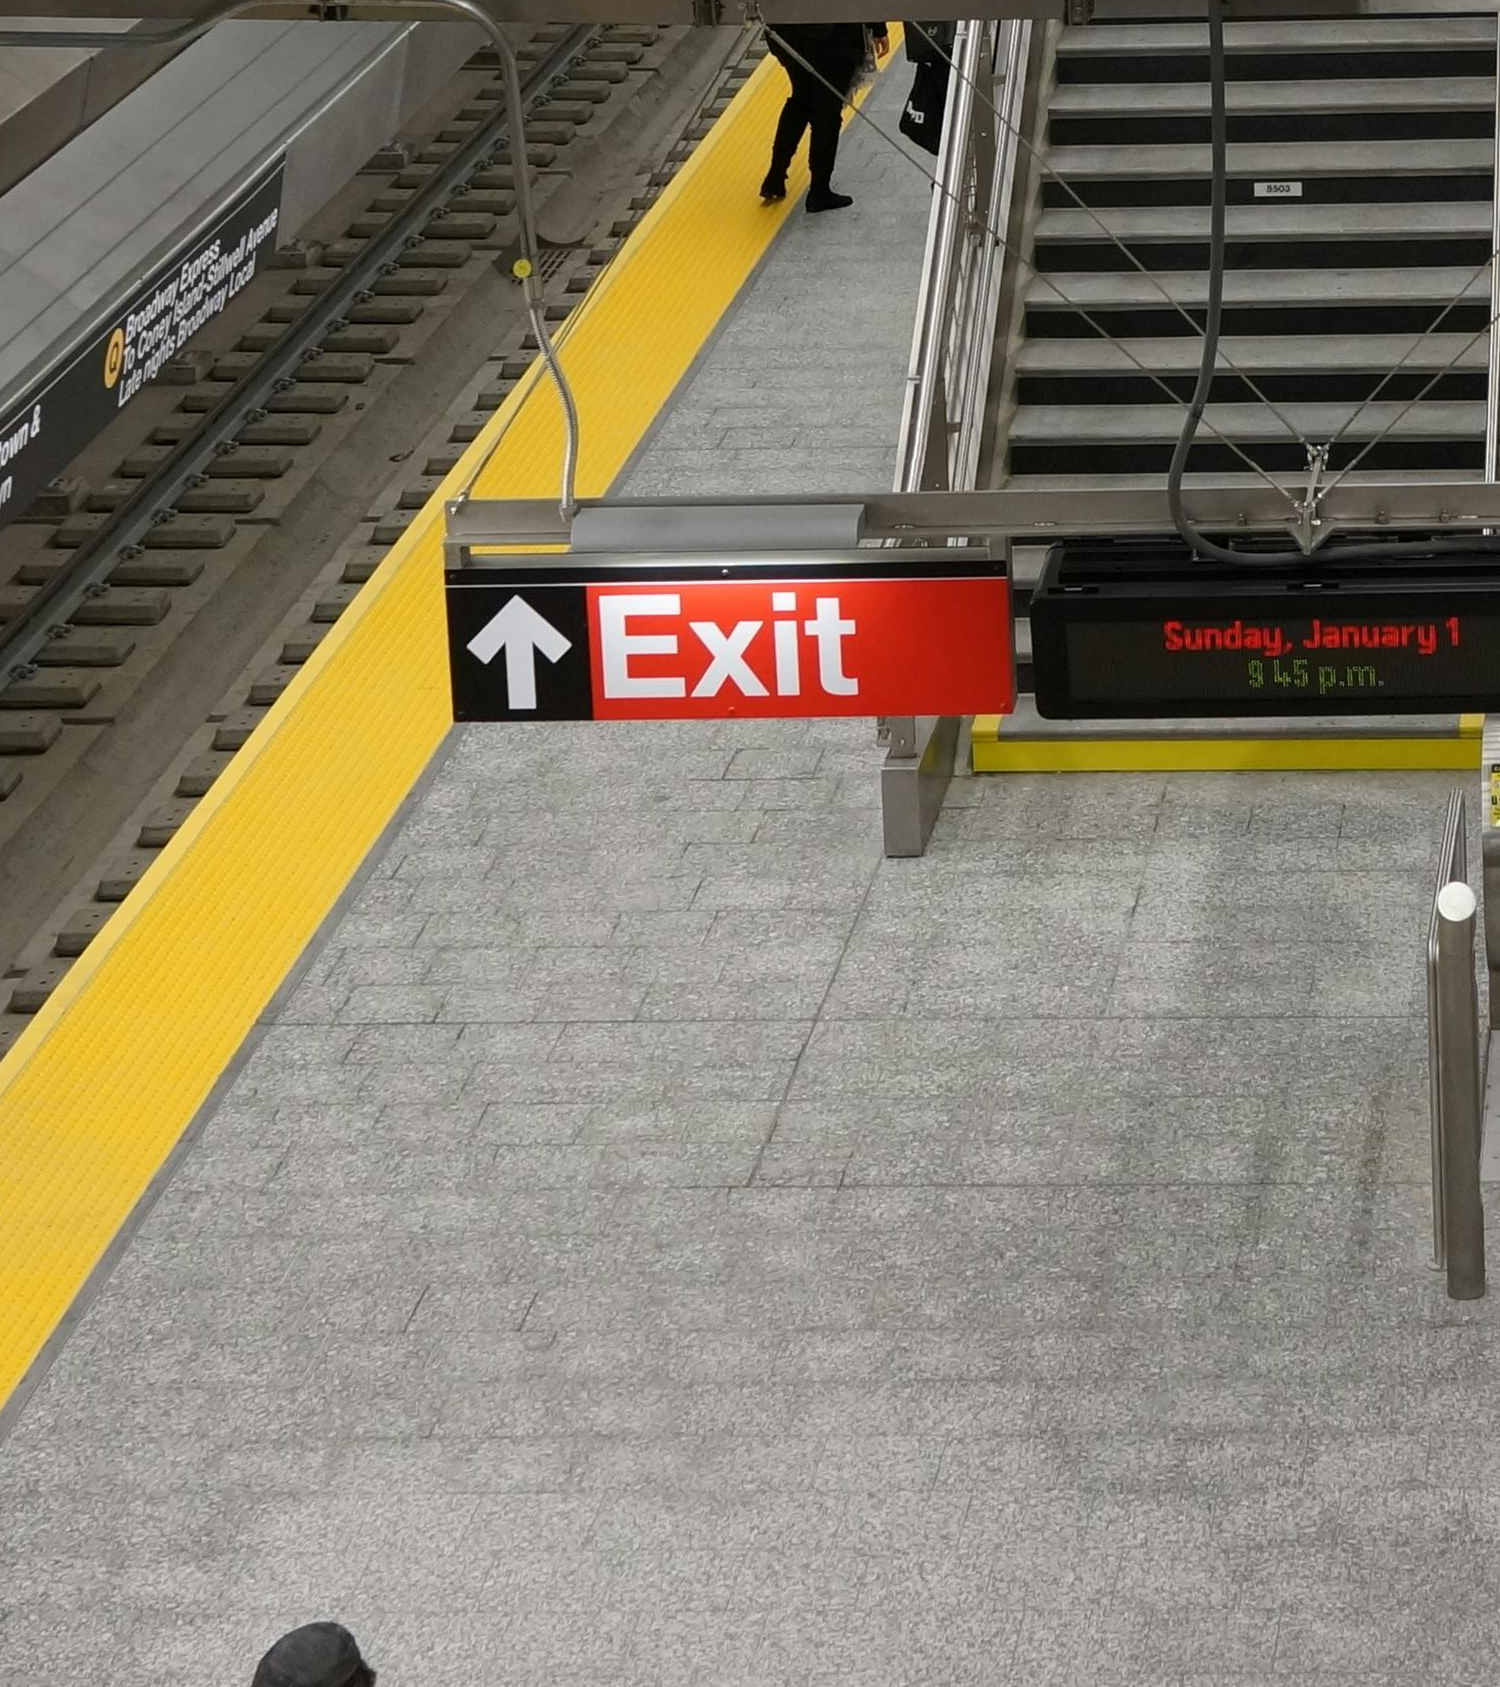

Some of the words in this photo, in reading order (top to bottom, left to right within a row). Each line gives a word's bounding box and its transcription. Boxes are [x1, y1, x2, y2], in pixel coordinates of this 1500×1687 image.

[118, 368, 142, 408] Late
[143, 335, 176, 382] nights
[176, 284, 229, 349] Broadway
[229, 251, 257, 298] Local
[123, 347, 135, 374] To
[137, 312, 173, 359] Coney
[173, 235, 246, 326] Island-Stillwell
[245, 208, 279, 257] Avenue
[125, 278, 179, 344] Broadway
[179, 239, 221, 293] Express
[30, 404, 41, 434] &
[598, 591, 860, 700] Exit
[1163, 619, 1294, 657] Sunday,
[1303, 617, 1437, 655] January
[1445, 616, 1460, 647] 1
[1319, 665, 1385, 695] p.m.
